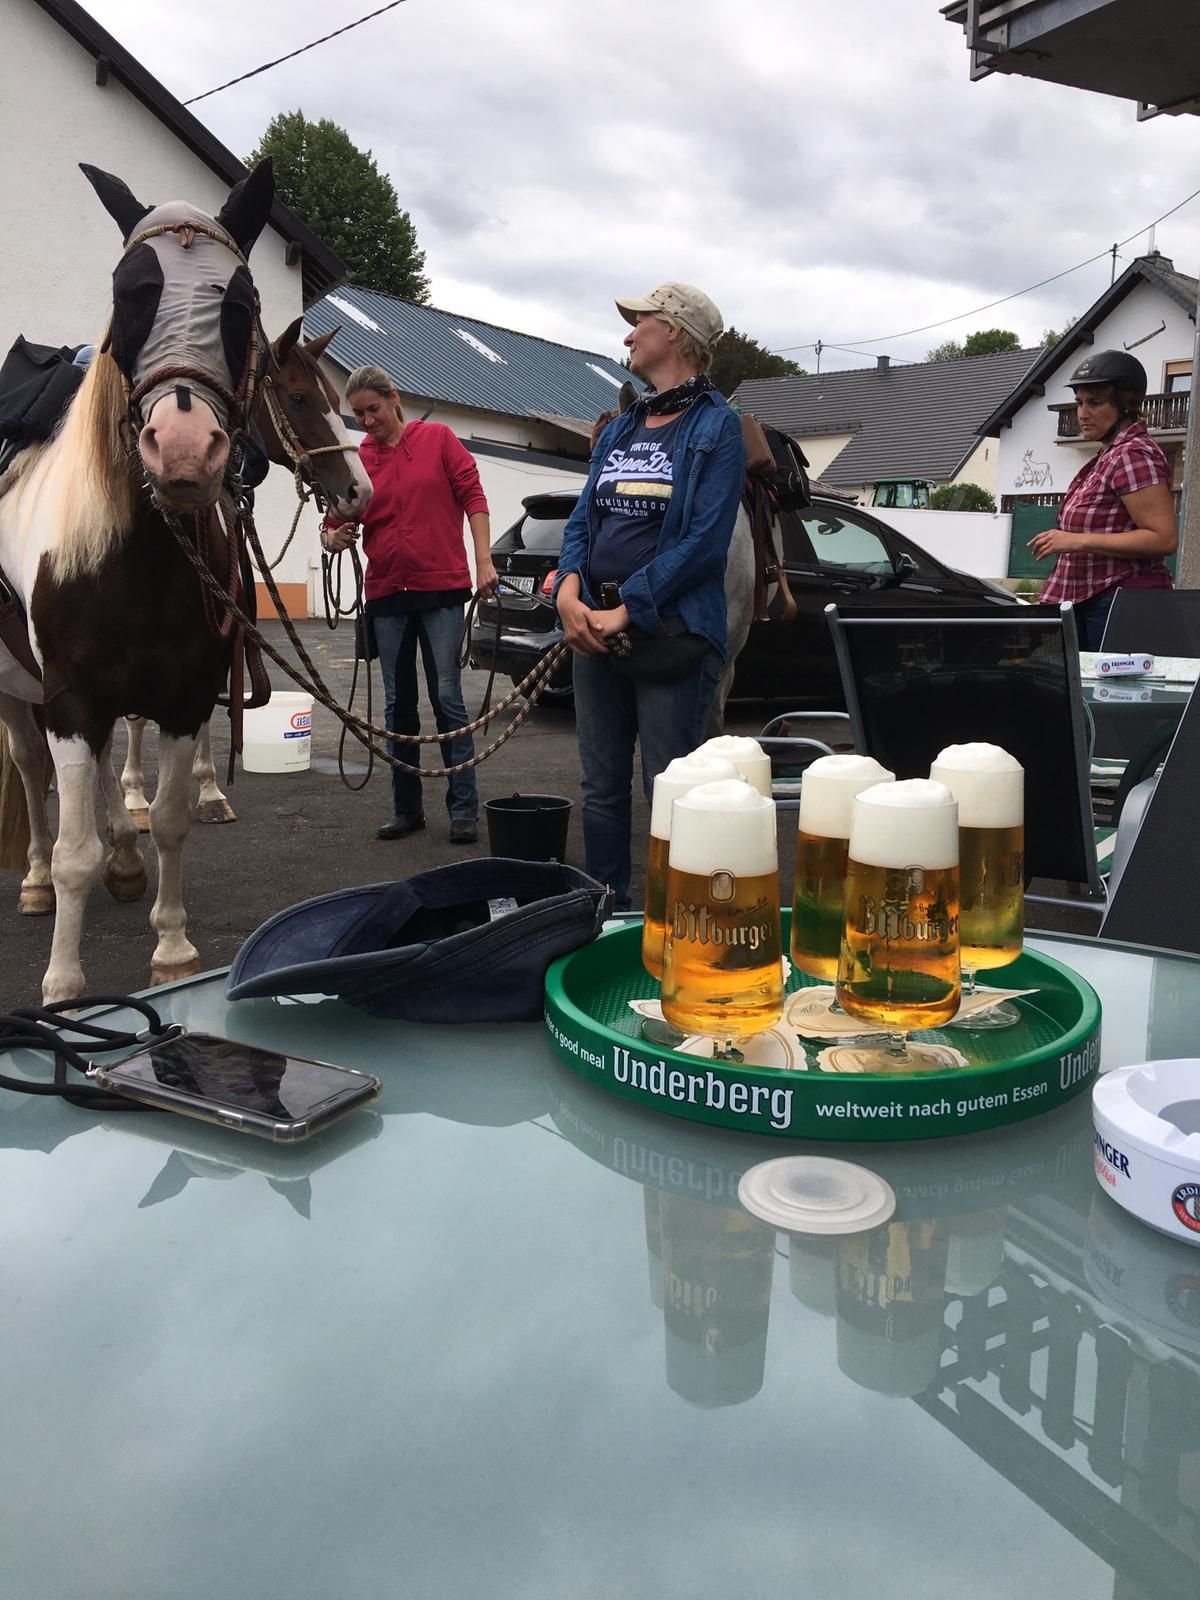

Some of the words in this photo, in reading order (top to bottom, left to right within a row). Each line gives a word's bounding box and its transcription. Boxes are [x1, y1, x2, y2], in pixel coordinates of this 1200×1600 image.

[630, 443, 662, 452] VINTAGE
[559, 1032, 579, 1056] good
[580, 1047, 605, 1070] meal
[612, 1045, 793, 1129] Underberg
[815, 1101, 903, 1118] weltweit
[909, 1098, 951, 1116] nach
[957, 1093, 1008, 1117] gutem
[1013, 1081, 1048, 1103] Essen
